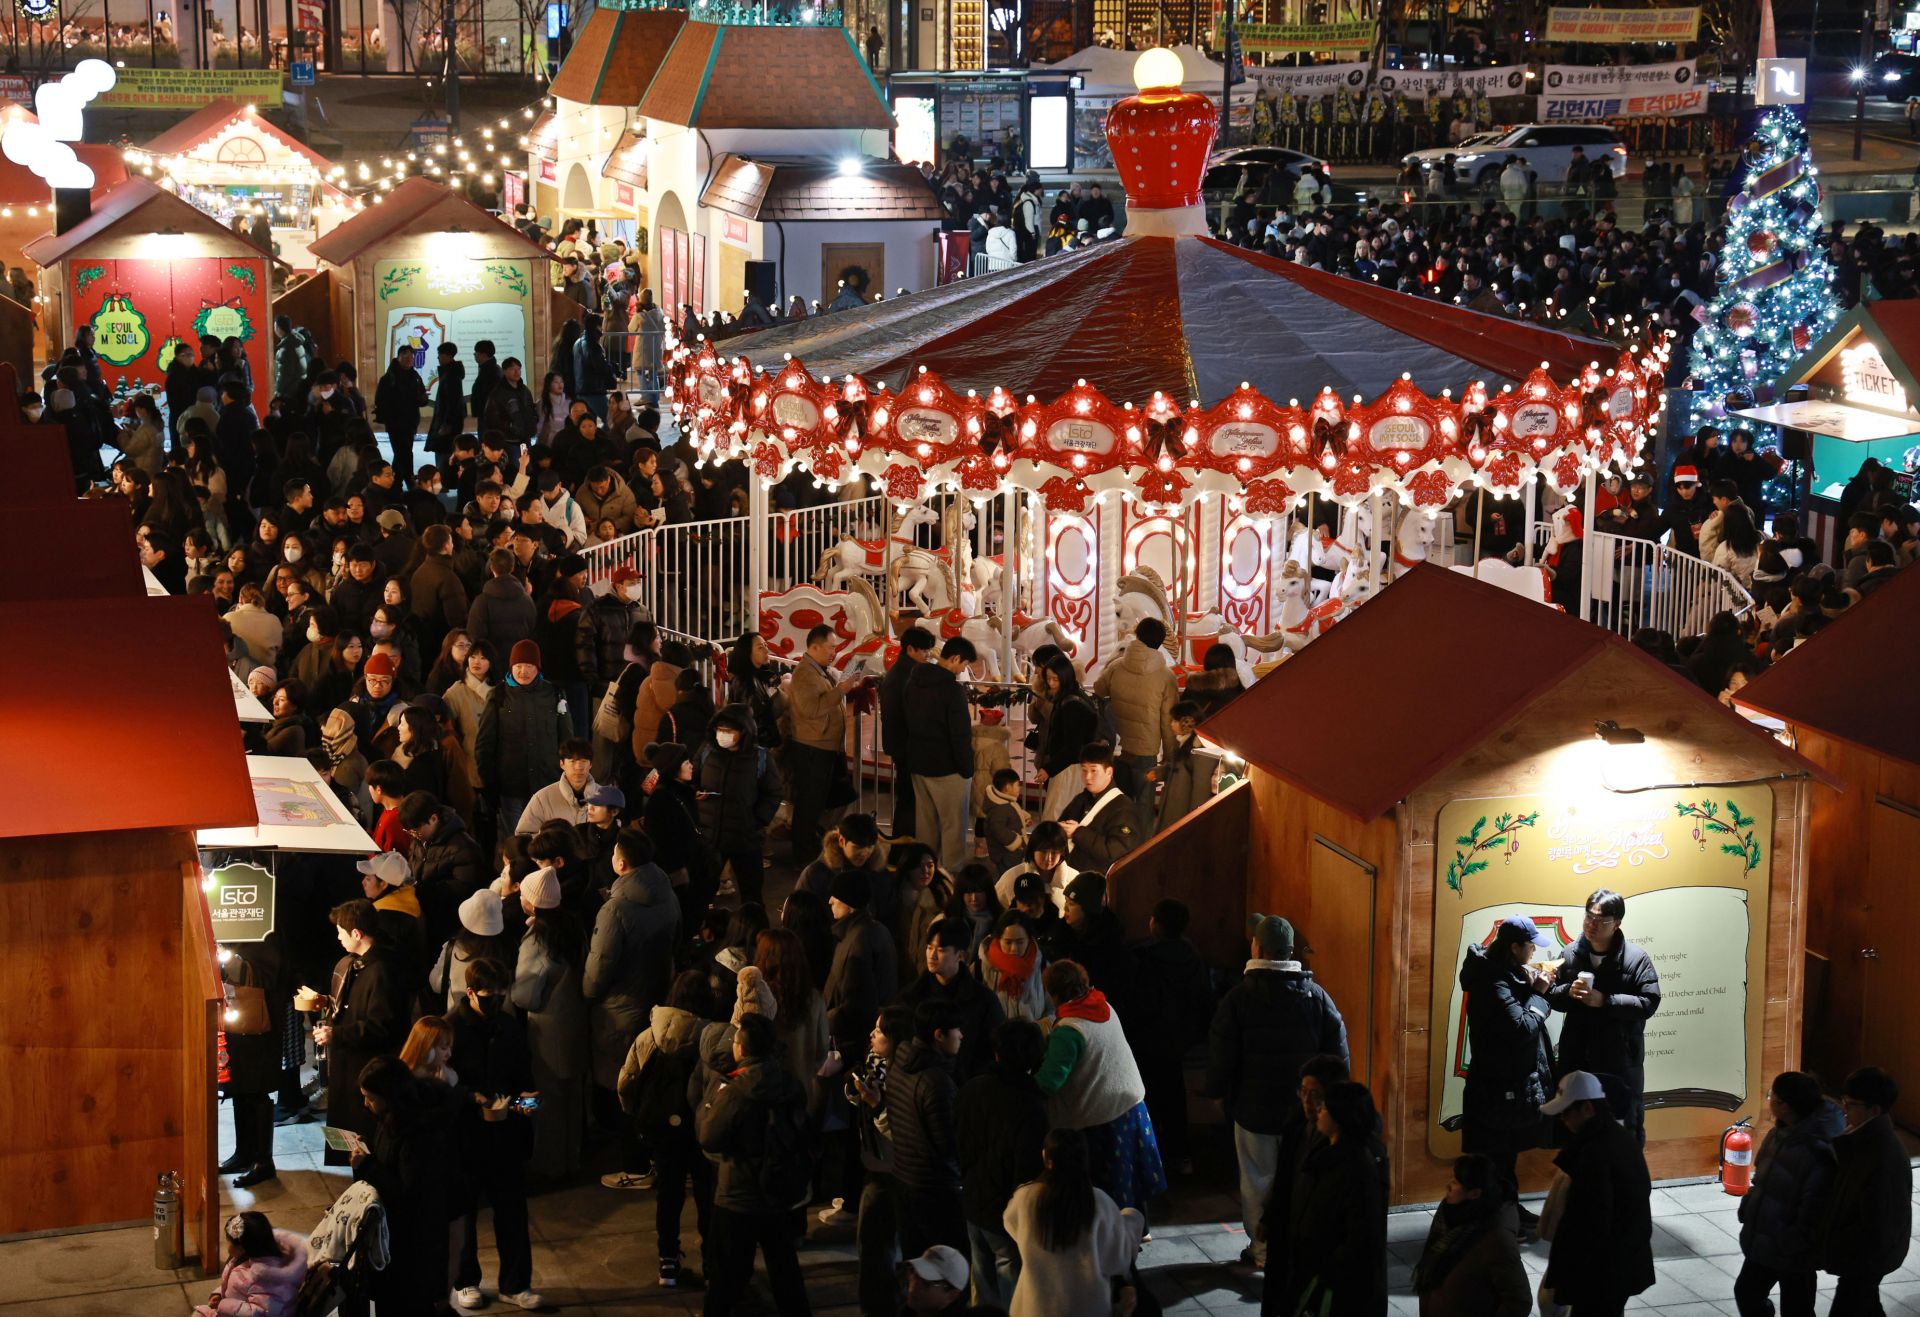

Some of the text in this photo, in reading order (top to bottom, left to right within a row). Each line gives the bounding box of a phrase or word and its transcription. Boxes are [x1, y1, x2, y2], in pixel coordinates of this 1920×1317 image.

[1547, 91, 1702, 118] 김현지를 특검하라
[116, 333, 138, 345] SOUL
[1854, 371, 1895, 396] TICKET
[1069, 423, 1093, 439] std
[1385, 423, 1416, 433] SEOUL
[1064, 439, 1097, 448] 서울관광재단
[221, 885, 257, 905] std
[212, 907, 264, 918] 서울관광재단
[1635, 935, 1654, 945] night
[1653, 951, 1687, 962] holy night
[1660, 971, 1682, 981] bright
[1668, 989, 1694, 999] Mother
[1695, 988, 1708, 996] and
[1709, 986, 1727, 995] Child
[1675, 1008, 1688, 1017] and
[1689, 1007, 1704, 1015] mild
[1659, 1030, 1677, 1038] peace
[1656, 1049, 1675, 1057] peace
